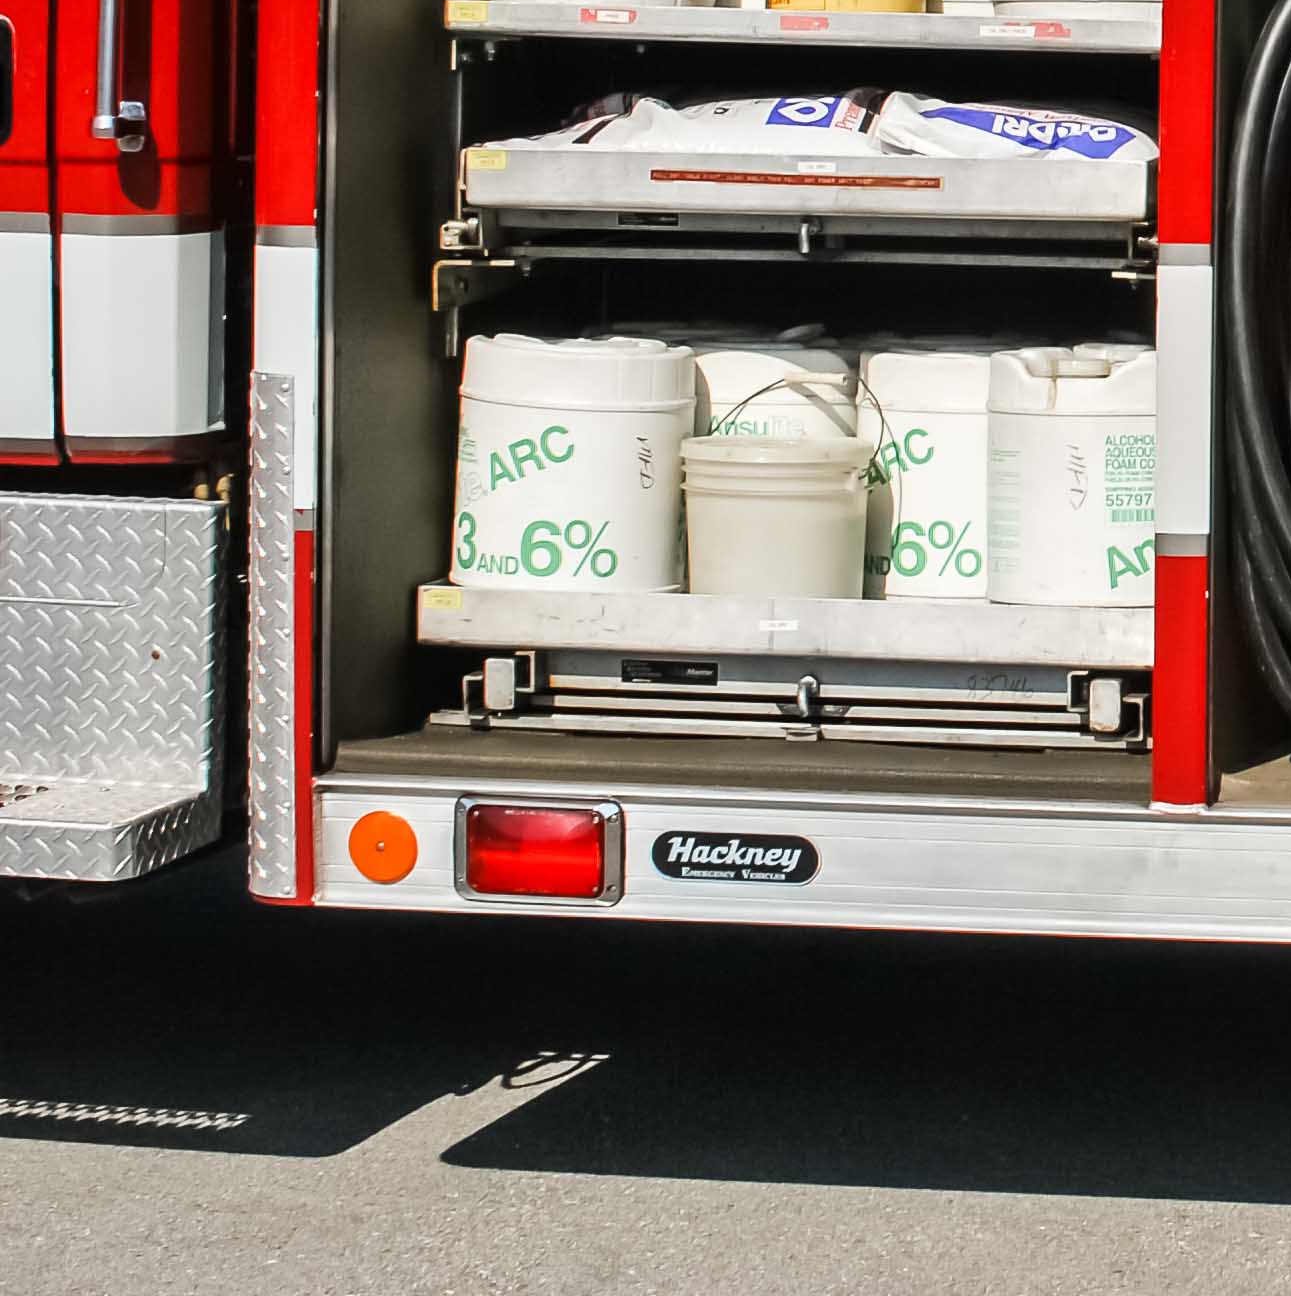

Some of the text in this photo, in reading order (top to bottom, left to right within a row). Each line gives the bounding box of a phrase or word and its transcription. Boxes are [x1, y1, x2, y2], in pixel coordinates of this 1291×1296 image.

[488, 425, 575, 491] ARC
[1105, 459, 1137, 470] FOAM
[1105, 493, 1153, 507] 55797
[456, 511, 619, 579] 3 AND 6%
[891, 520, 983, 578] 6%
[667, 836, 802, 873] Hackney
